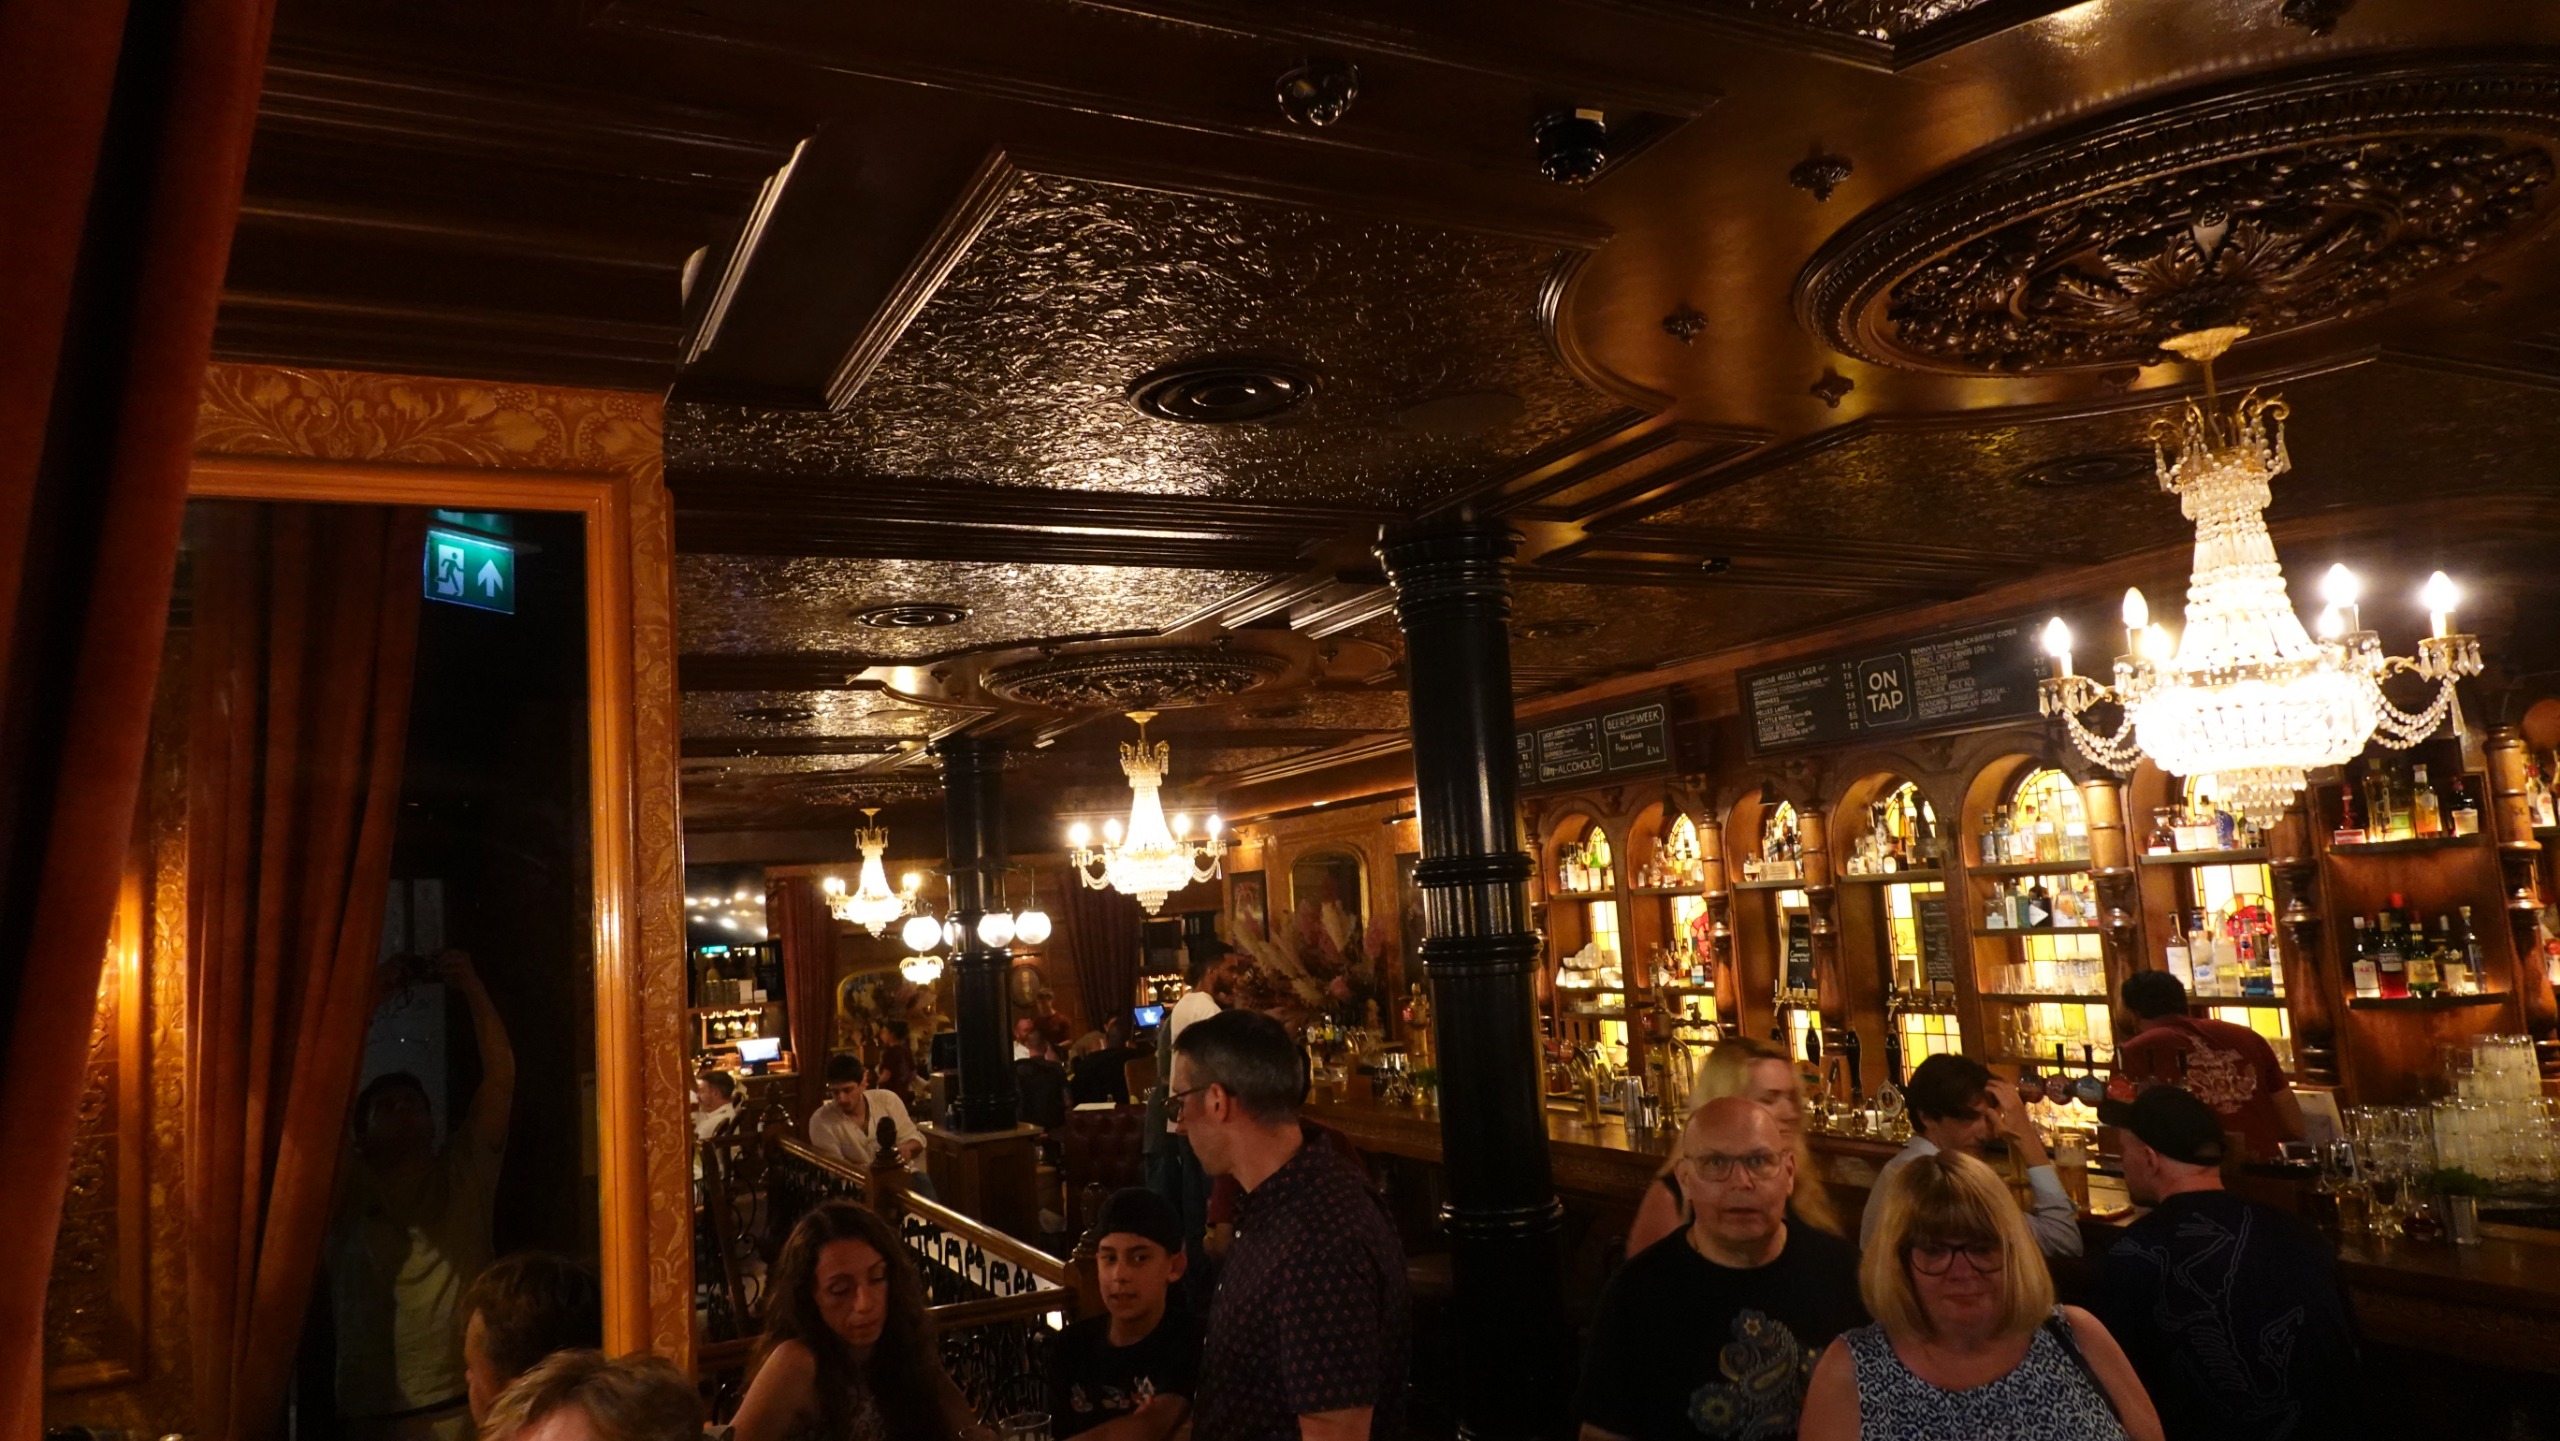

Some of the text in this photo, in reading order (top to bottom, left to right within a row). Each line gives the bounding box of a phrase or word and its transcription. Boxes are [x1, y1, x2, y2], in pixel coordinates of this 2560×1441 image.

[1996, 628, 2017, 638] CIDER
[1798, 665, 1817, 677] LAGER
[1869, 669, 1898, 691] ON
[1866, 690, 1903, 712] TAP
[1607, 717, 1626, 730] BEER
[1636, 710, 1660, 723] WEEK
